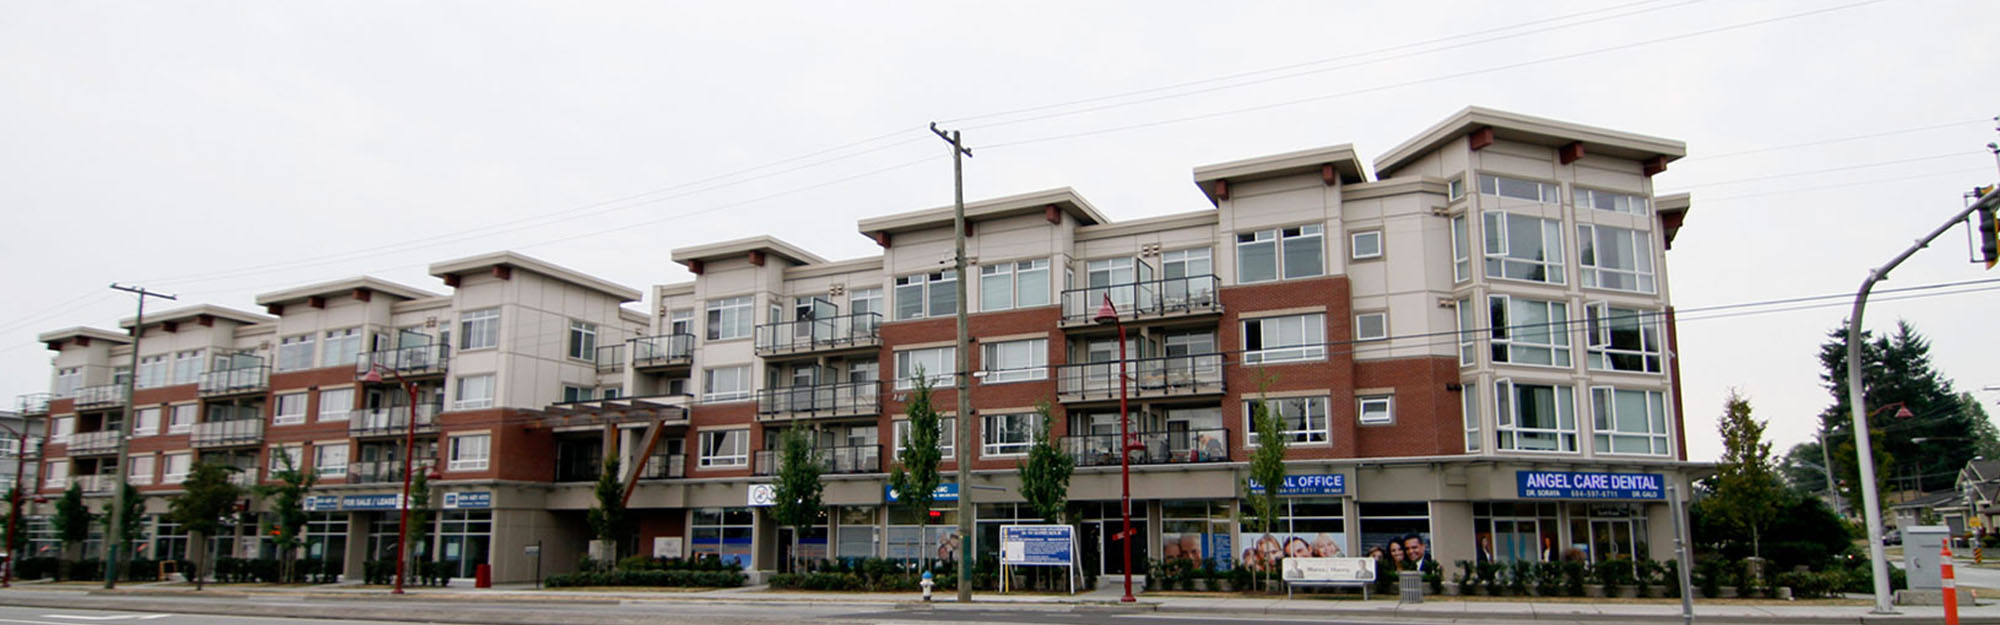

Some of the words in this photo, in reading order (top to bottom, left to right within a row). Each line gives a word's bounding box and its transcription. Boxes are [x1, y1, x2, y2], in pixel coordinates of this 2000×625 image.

[1298, 476, 1342, 487] OFFICE
[1526, 473, 1572, 488] ANGEL
[1573, 474, 1608, 489] CARE
[1611, 475, 1659, 490] DENTAL
